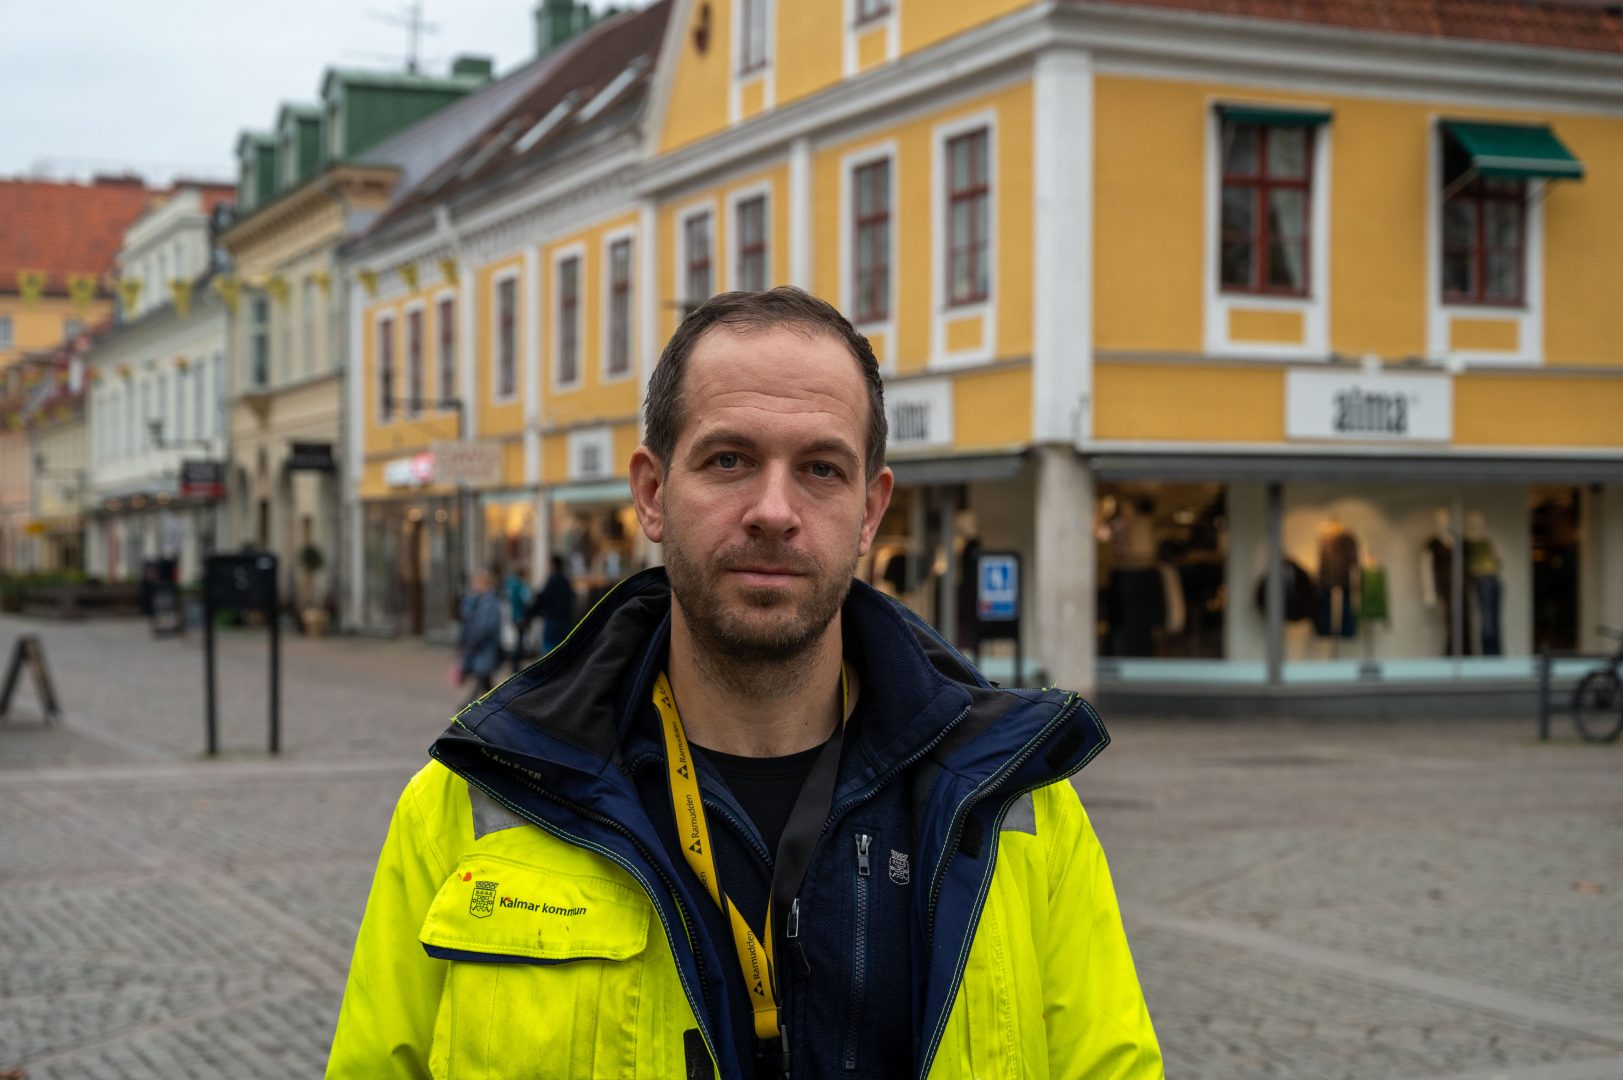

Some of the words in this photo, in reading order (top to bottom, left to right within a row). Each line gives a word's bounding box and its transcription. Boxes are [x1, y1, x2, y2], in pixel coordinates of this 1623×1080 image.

[1333, 387, 1408, 434] alma
[673, 721, 687, 763] Ramudden
[685, 794, 700, 839] Ramudden
[499, 896, 541, 913] Kalmar
[541, 902, 588, 917] kommun
[745, 930, 761, 980] Ramudden
